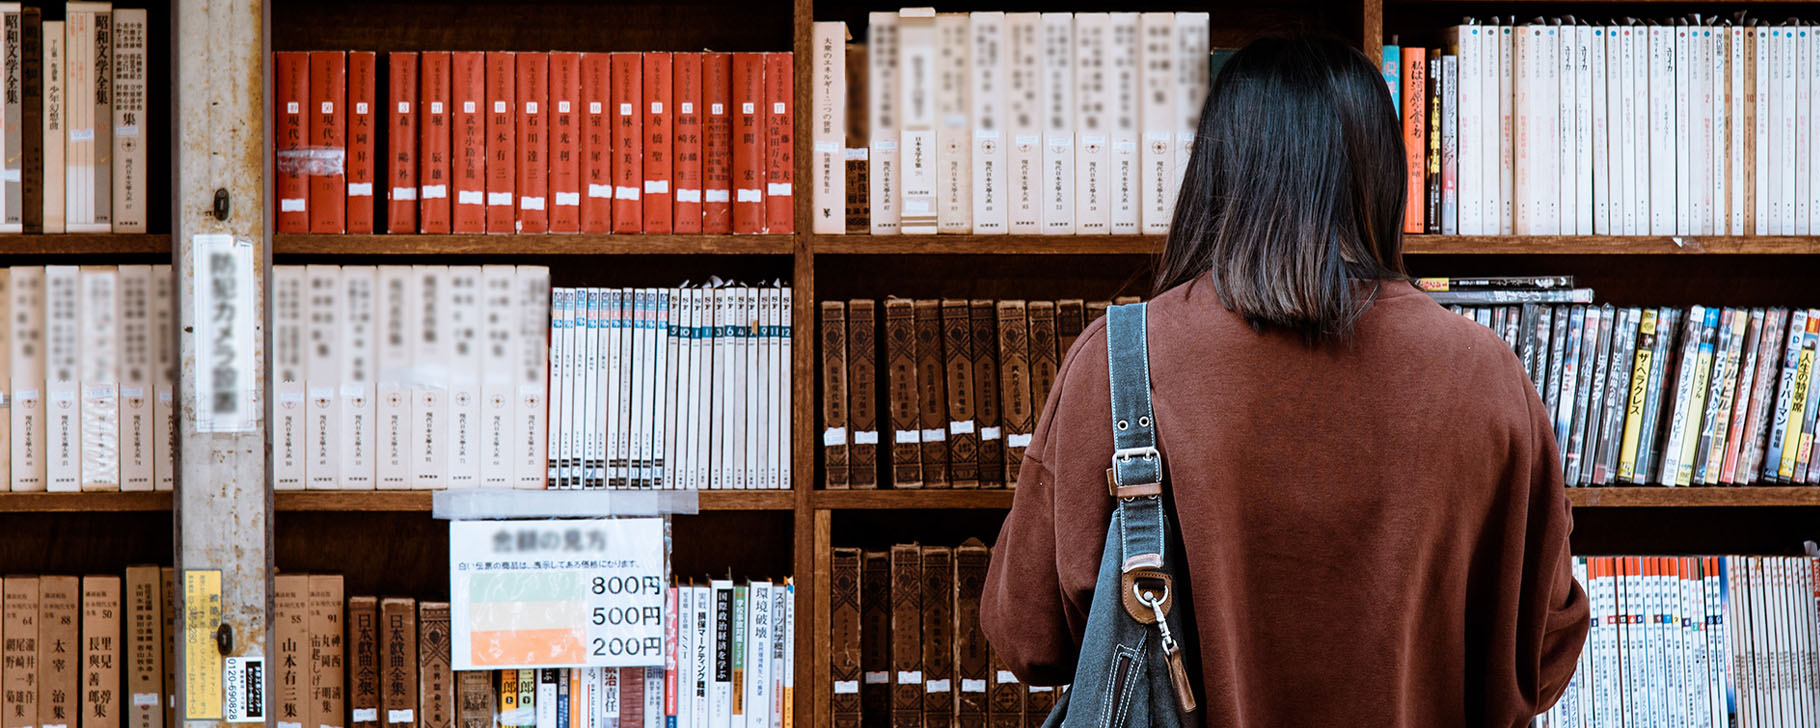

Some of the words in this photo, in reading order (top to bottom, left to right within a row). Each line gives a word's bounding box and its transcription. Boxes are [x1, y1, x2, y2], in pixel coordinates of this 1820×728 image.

[6, 15, 18, 104] 昭和文学全集
[96, 15, 108, 104] 昭和文学全集
[123, 112, 136, 126] 集
[357, 116, 367, 180] 大岡昇平
[432, 116, 442, 180] 堀辰雄
[496, 116, 507, 179] 山本有三
[528, 116, 538, 179] 石川達三
[591, 116, 601, 180] 室生犀星
[622, 117, 632, 181] 林芙美子
[653, 116, 663, 176] 舟橋聖一
[744, 116, 754, 181] 野間宏
[770, 117, 780, 180] 久保田万太郎
[780, 116, 791, 181] 佐藤春夫
[671, 327, 677, 335] 5
[680, 328, 690, 336] 10
[717, 328, 722, 336] 3
[727, 327, 734, 335] 6
[782, 328, 790, 336] 12
[1630, 352, 1648, 415] ザ・ヘラクレス
[1718, 356, 1740, 411] キル・ビル
[1776, 371, 1794, 426] スーパーマン
[1792, 353, 1810, 413] 人生の特等席
[103, 610, 112, 619] 50
[592, 576, 660, 595] 800円
[756, 587, 768, 639] 環境破壊
[23, 617, 32, 625] 64
[61, 616, 71, 625] 88
[292, 615, 301, 624] 55
[327, 614, 337, 624] 91
[592, 607, 661, 626] 500円
[593, 637, 662, 656] 200円
[717, 592, 728, 680] 国際政治経済を学ぶ
[774, 592, 784, 659] スポーツ科学概論
[16, 639, 26, 705] 尾崎一雄
[26, 639, 35, 705] 瀧井孝作
[53, 640, 65, 720] 太宰治集
[228, 658, 237, 720] 0120-690828
[283, 638, 297, 717] 山本有三集
[312, 636, 321, 699] 由起しげ子
[322, 635, 331, 699] 丸岡明
[15, 706, 24, 718] 集
[95, 704, 106, 718] 集
[322, 700, 331, 713] 集
